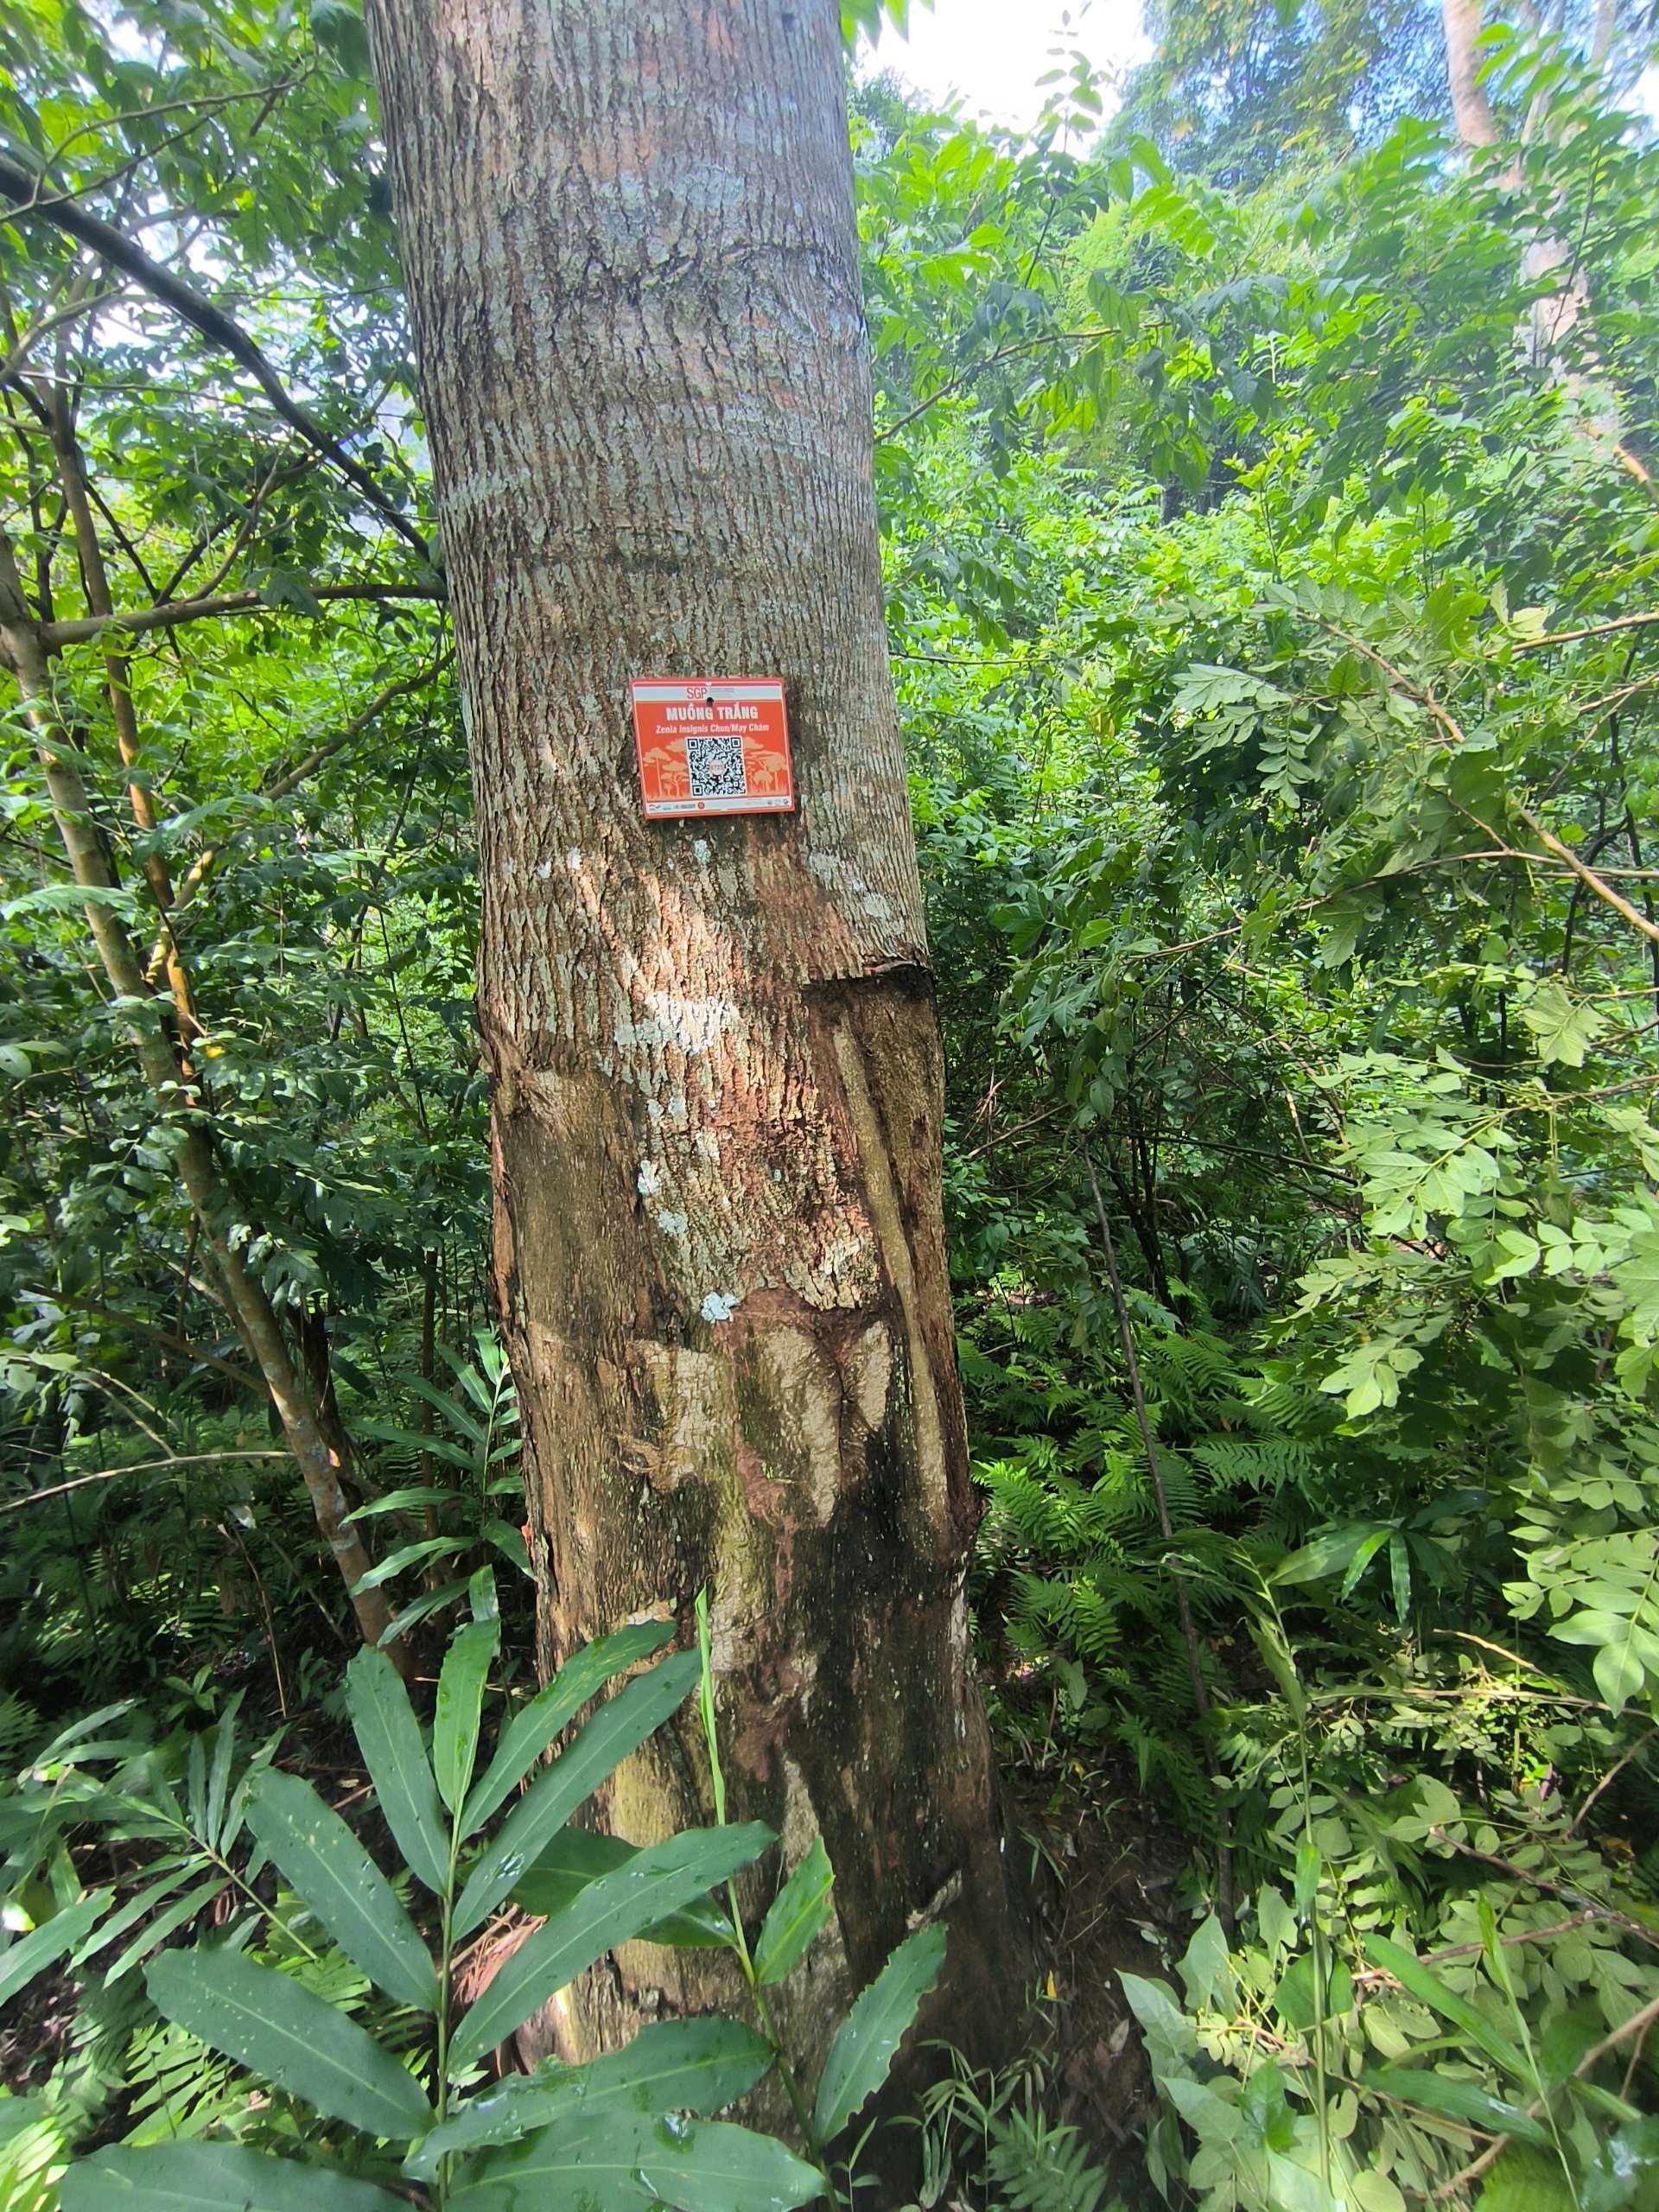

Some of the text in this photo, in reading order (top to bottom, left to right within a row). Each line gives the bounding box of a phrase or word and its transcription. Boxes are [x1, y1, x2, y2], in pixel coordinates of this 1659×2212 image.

[686, 687, 707, 699] SGP
[656, 725, 677, 734] Zenia
[679, 724, 708, 734] insignis
